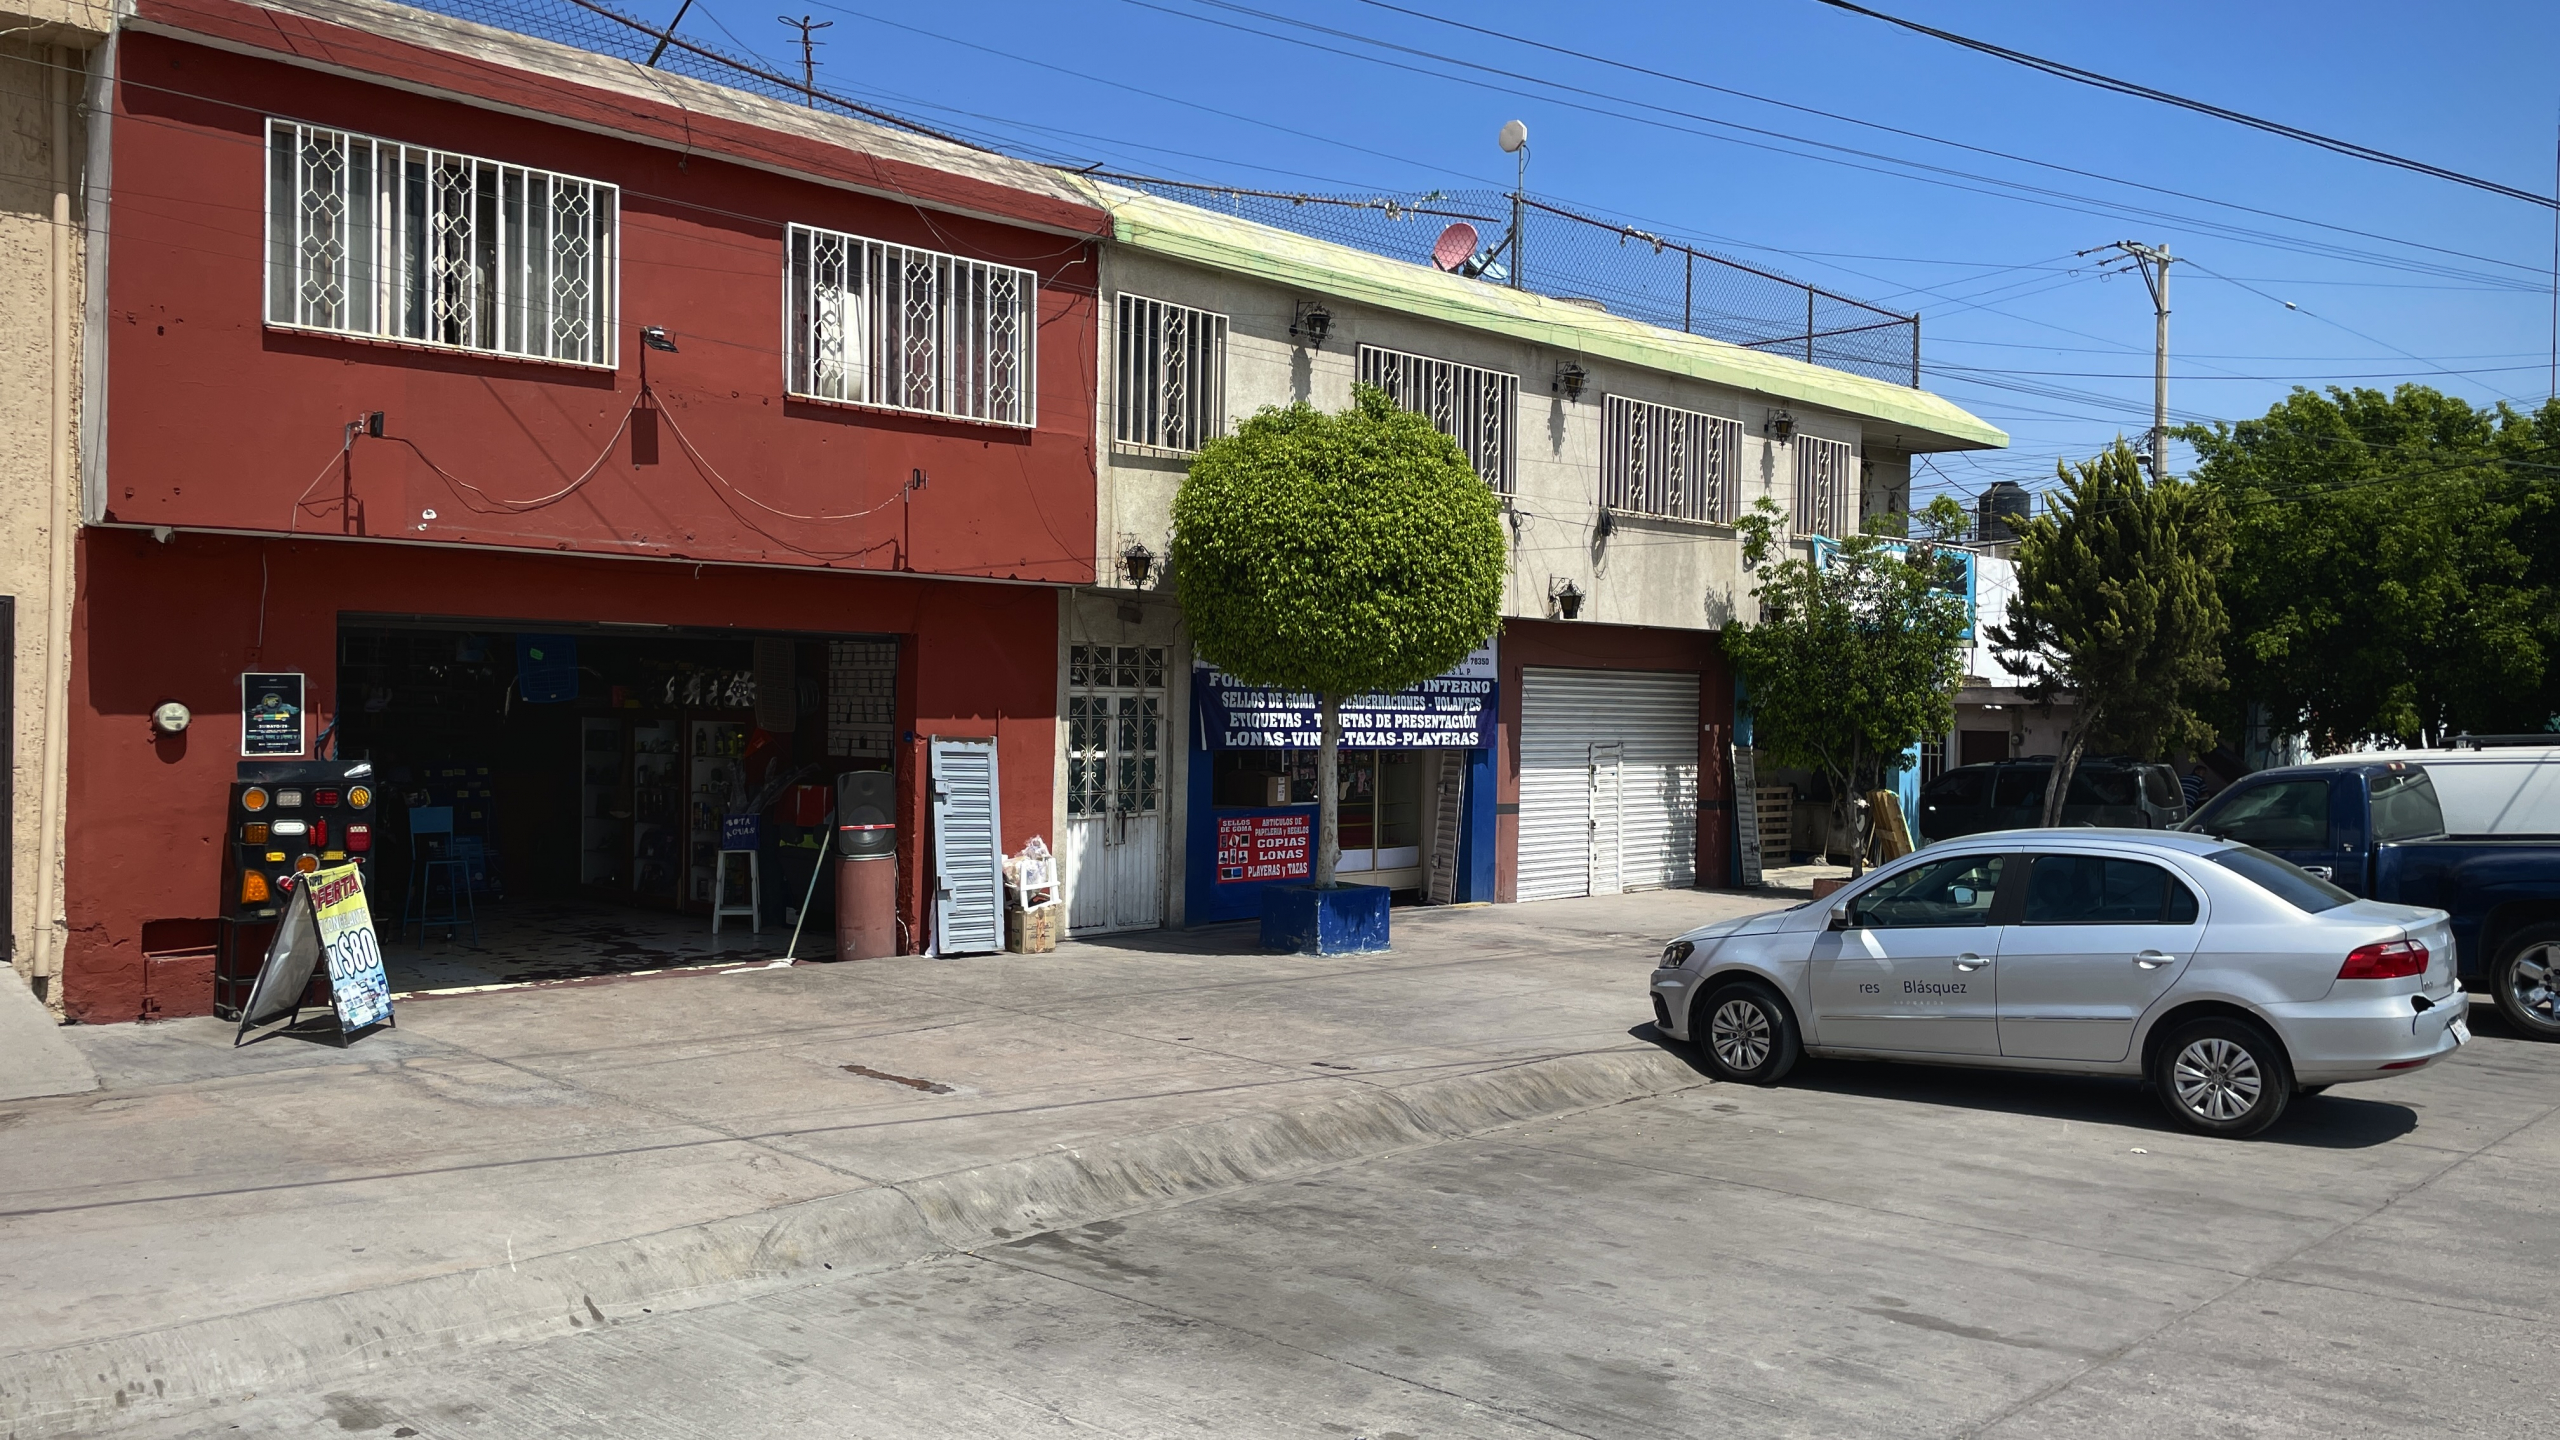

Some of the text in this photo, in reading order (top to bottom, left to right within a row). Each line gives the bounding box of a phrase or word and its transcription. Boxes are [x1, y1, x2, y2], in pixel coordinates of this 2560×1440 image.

[1423, 680, 1490, 694] INTERNO
[1221, 691, 1266, 709] SELLOS
[1267, 692, 1283, 709] DE
[1286, 692, 1316, 709] GOMA
[1434, 696, 1482, 712] VOLANTES
[1229, 712, 1302, 729] ETIQUETAS
[1375, 713, 1392, 729] DE
[1394, 711, 1478, 729] PRESENTACIÓN
[726, 818, 751, 827] BOTA
[1222, 819, 1251, 827] SELLOS
[1262, 817, 1302, 827] ARTICULOS DE
[1255, 828, 1282, 836] PAPELERIA
[1287, 826, 1309, 834] REGALOS
[1257, 837, 1306, 848] COPIAS
[1259, 849, 1304, 860] LONAS
[1248, 864, 1280, 877] PLAYERAS
[1287, 862, 1308, 875] TAZAS
[338, 927, 379, 979] $80
[1859, 980, 1967, 996] res Blásquez
